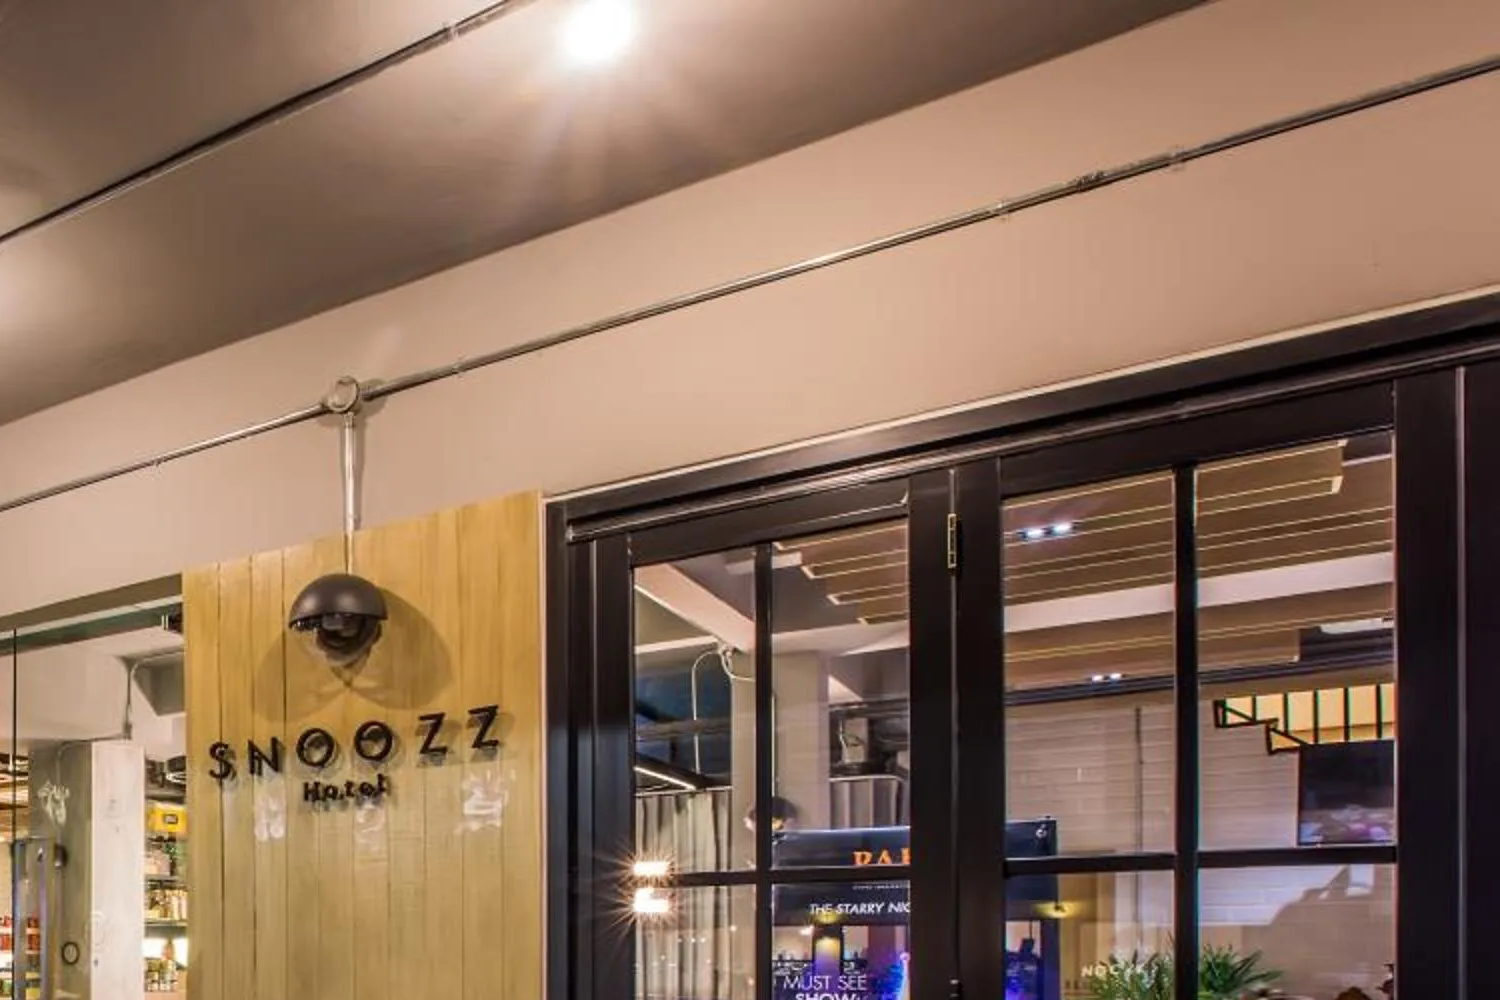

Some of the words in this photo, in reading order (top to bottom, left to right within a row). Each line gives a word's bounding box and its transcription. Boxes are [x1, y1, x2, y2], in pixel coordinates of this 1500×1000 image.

[209, 705, 499, 779] SNOOZZ
[810, 903, 833, 914] THE
[836, 902, 884, 914] STARRY
[783, 975, 832, 991] MUST
[837, 974, 868, 991] SEE
